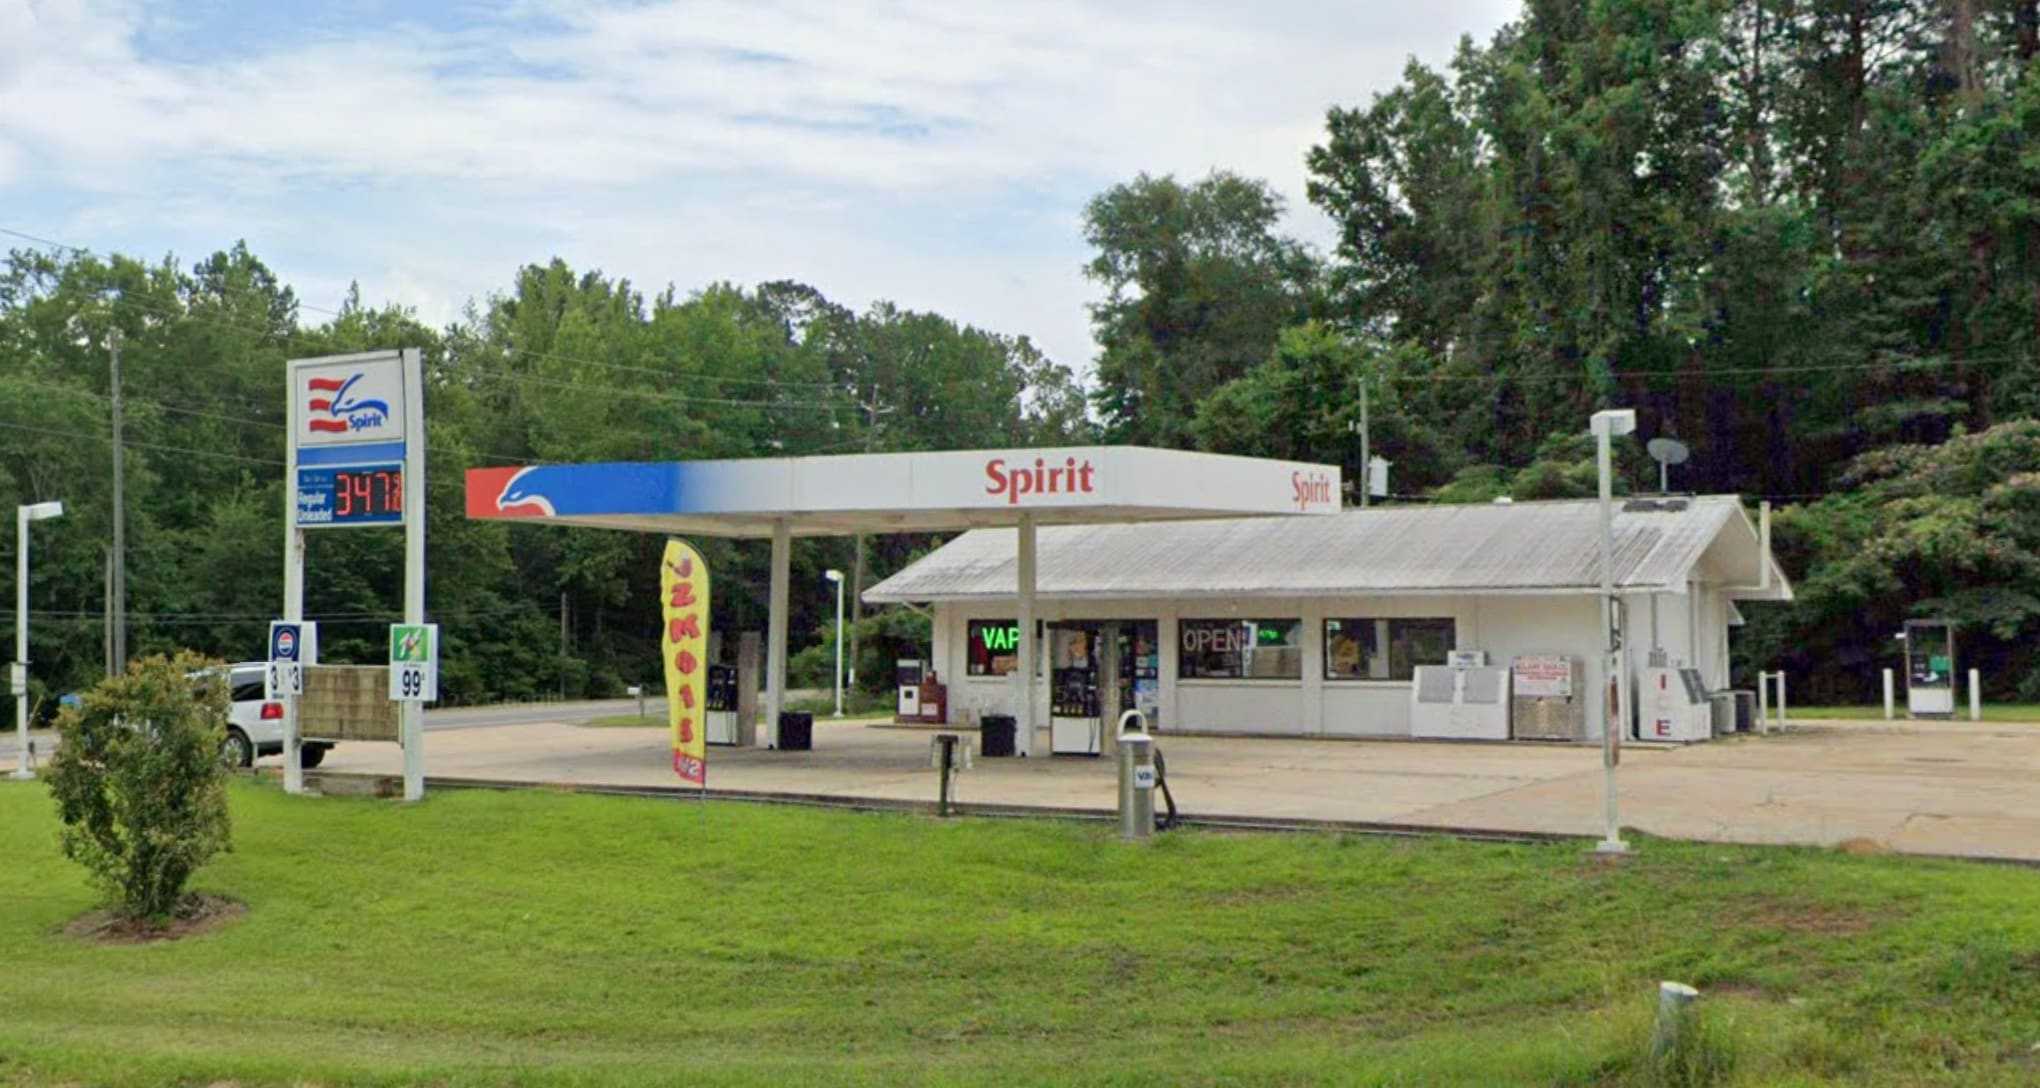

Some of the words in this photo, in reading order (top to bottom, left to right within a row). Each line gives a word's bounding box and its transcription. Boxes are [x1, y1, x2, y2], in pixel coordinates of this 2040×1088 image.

[349, 412, 382, 431] Spirit
[984, 457, 1095, 504] Spirit
[1292, 471, 1331, 511] Spirit
[982, 626, 1020, 650] VAP
[1183, 629, 1241, 652] OPEN
[1654, 674, 1672, 737] IE
